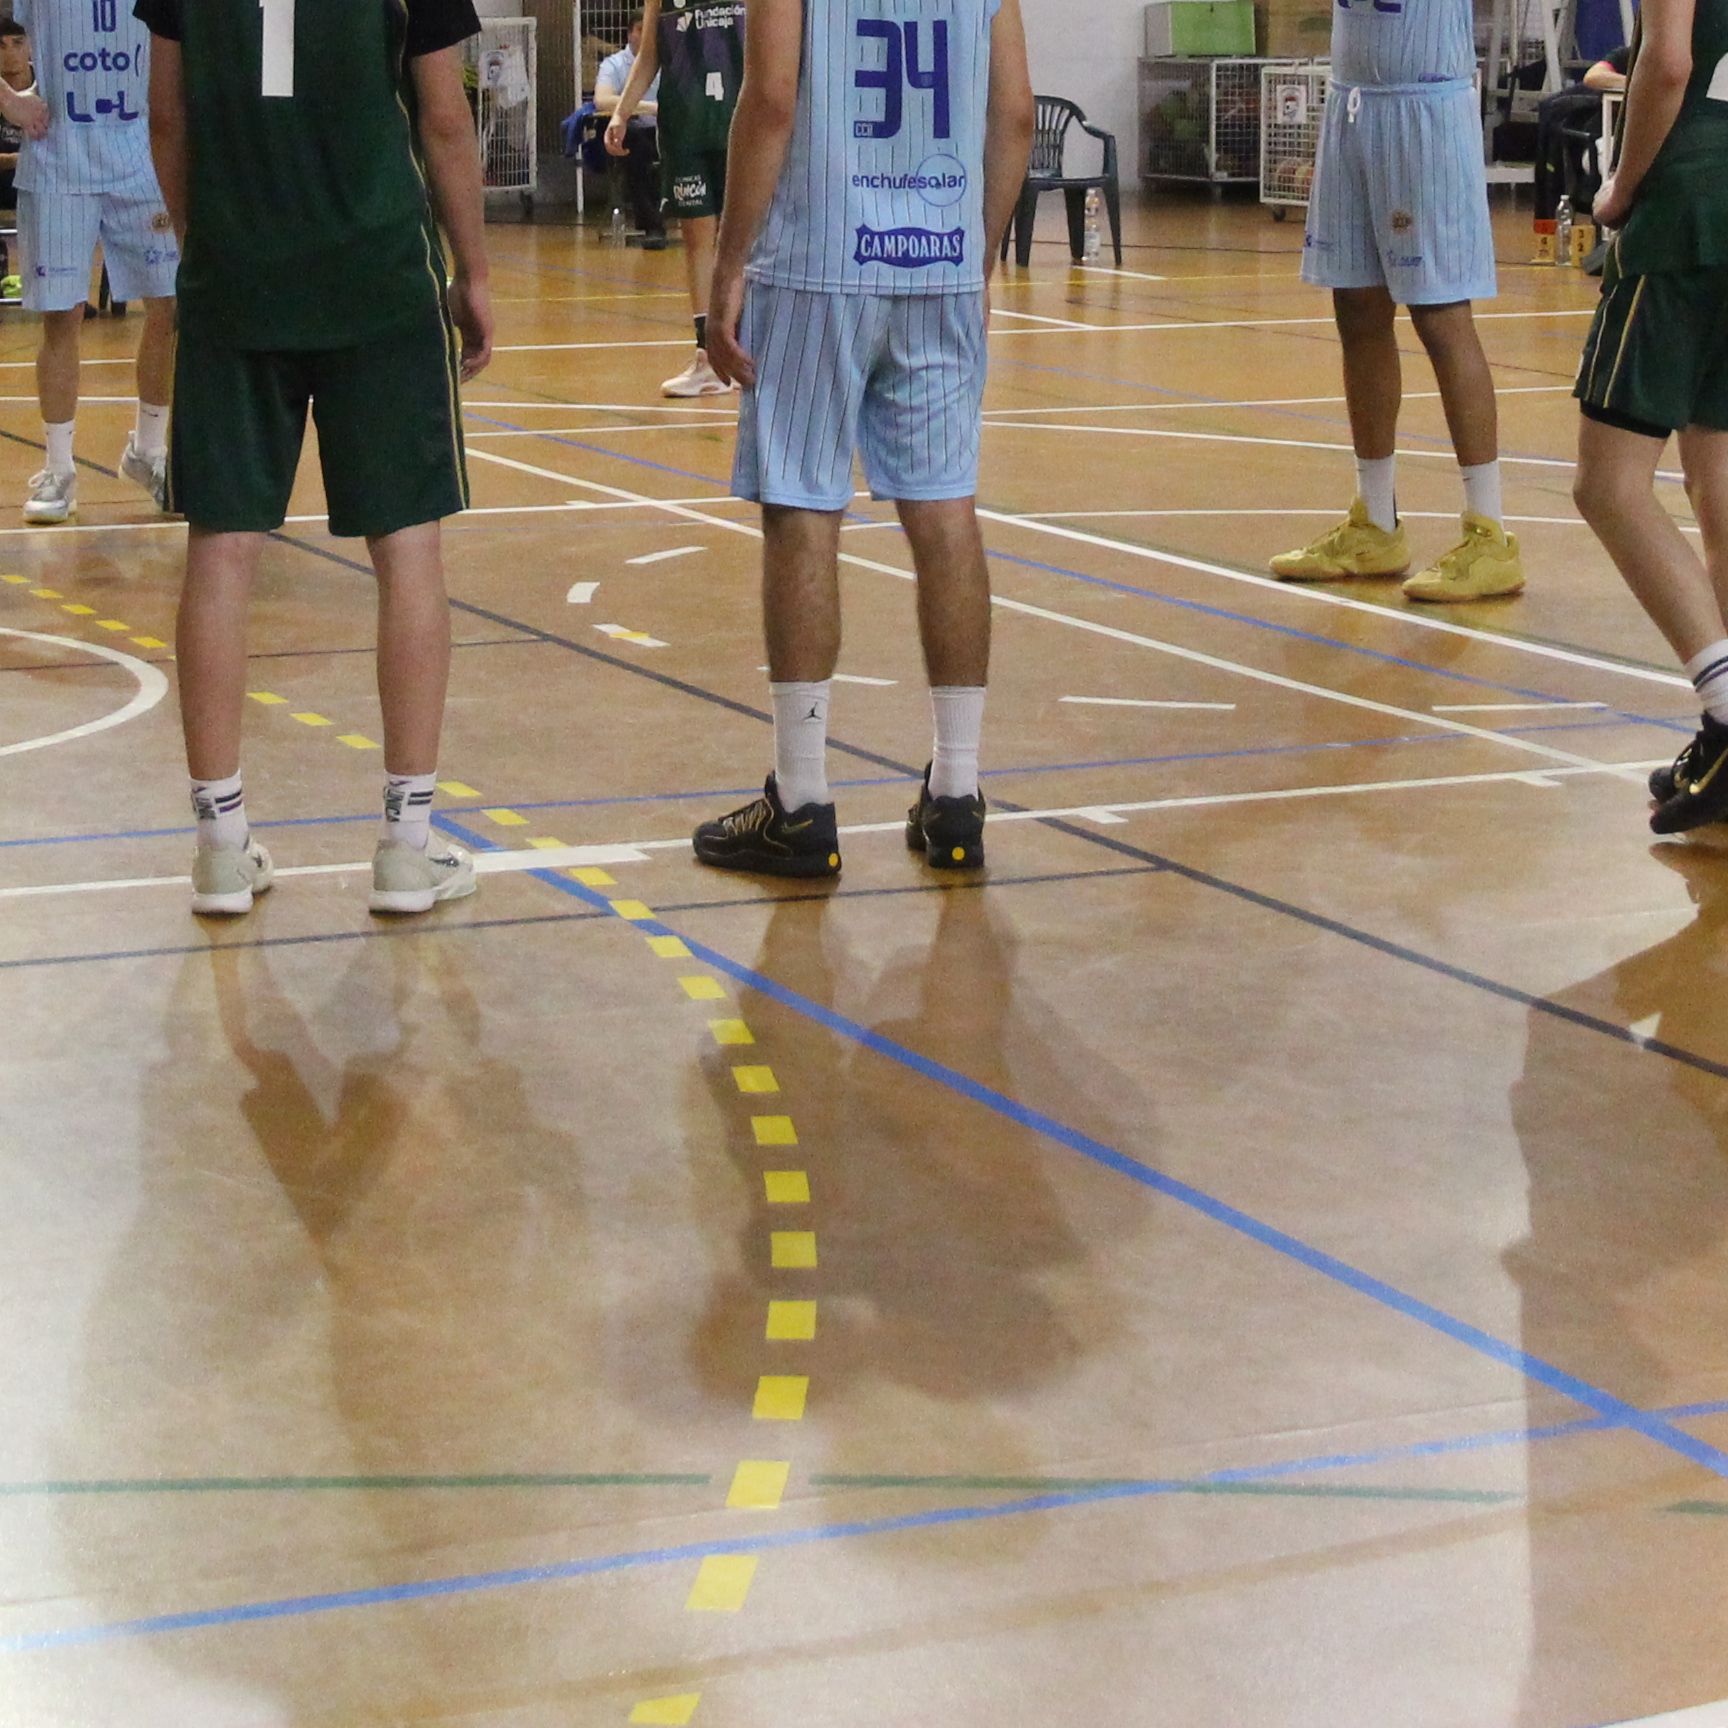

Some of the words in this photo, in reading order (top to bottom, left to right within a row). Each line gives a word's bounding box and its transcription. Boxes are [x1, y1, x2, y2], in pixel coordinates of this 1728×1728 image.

[694, 5, 747, 20] Fundación
[695, 16, 734, 30] Unicaja
[705, 72, 725, 101] 4
[853, 19, 951, 139] 34
[852, 172, 966, 190] enchufesolar
[860, 233, 961, 259] CAMPOARAS
